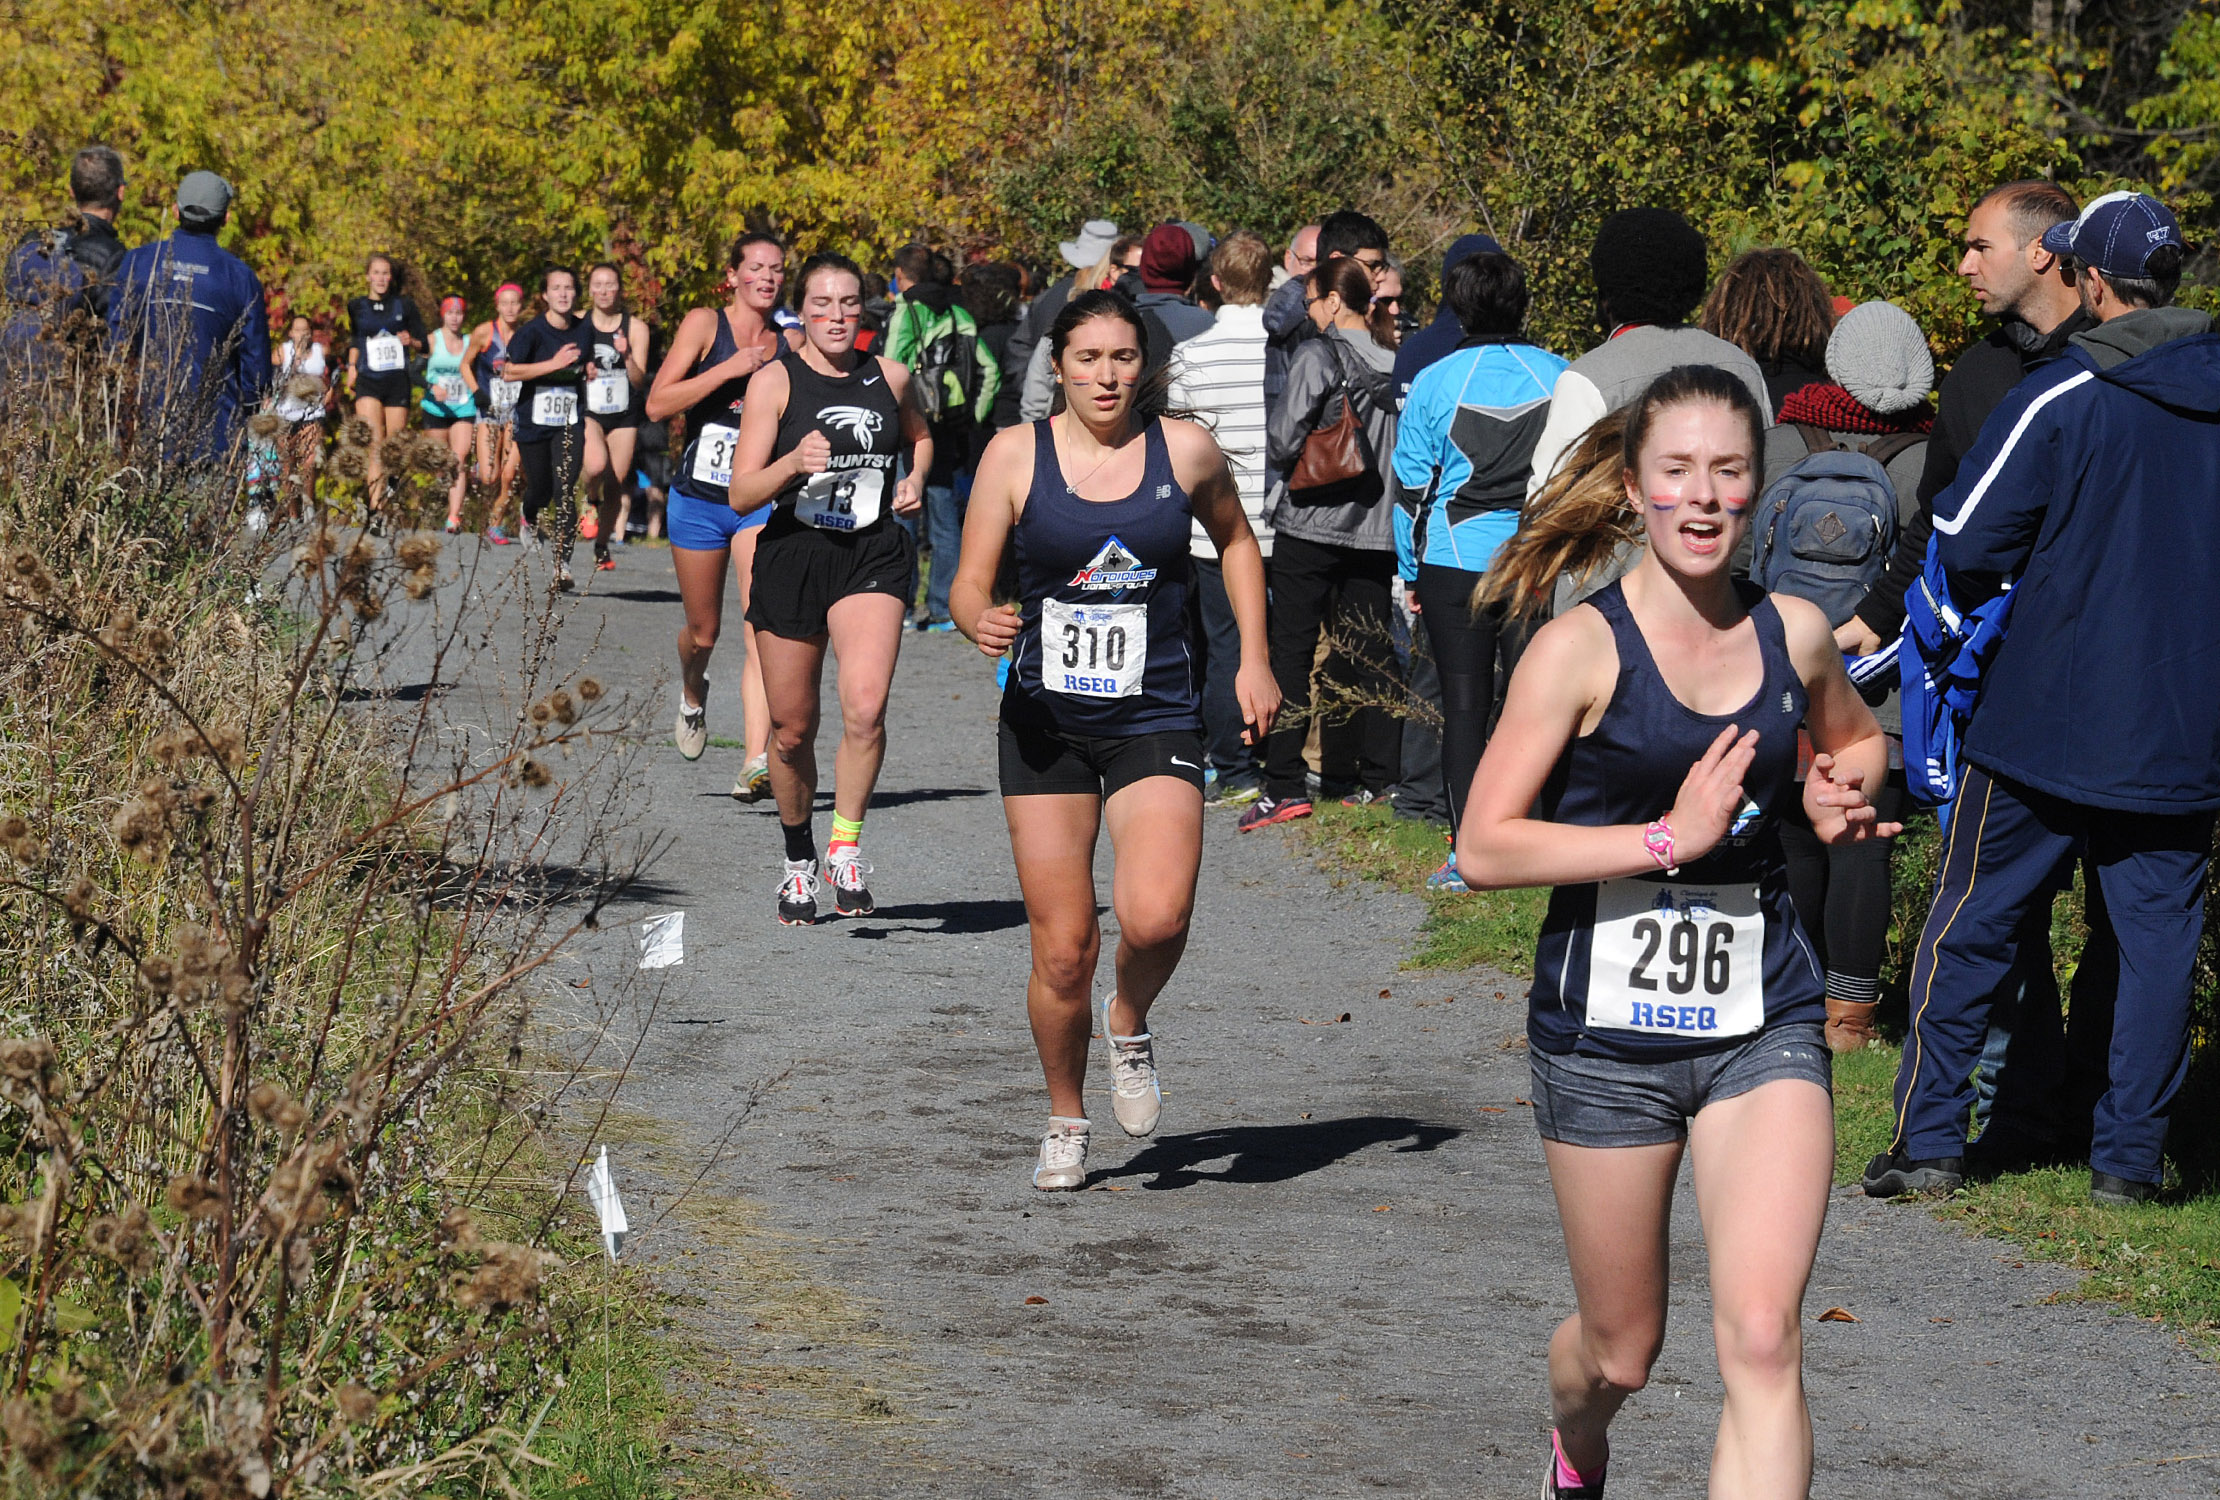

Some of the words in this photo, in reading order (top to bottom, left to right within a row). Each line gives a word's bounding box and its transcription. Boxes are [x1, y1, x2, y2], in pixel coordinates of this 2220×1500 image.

[543, 396, 571, 414] 366
[606, 386, 613, 403] 8
[710, 440, 736, 470] 31
[710, 471, 732, 483] RS
[828, 480, 857, 515] 13
[814, 513, 856, 530] RSEQ
[1062, 623, 1126, 672] 310
[1063, 674, 1118, 693] RSEQ
[1628, 917, 1735, 995] 296
[1629, 1001, 1718, 1031] RSEQ
